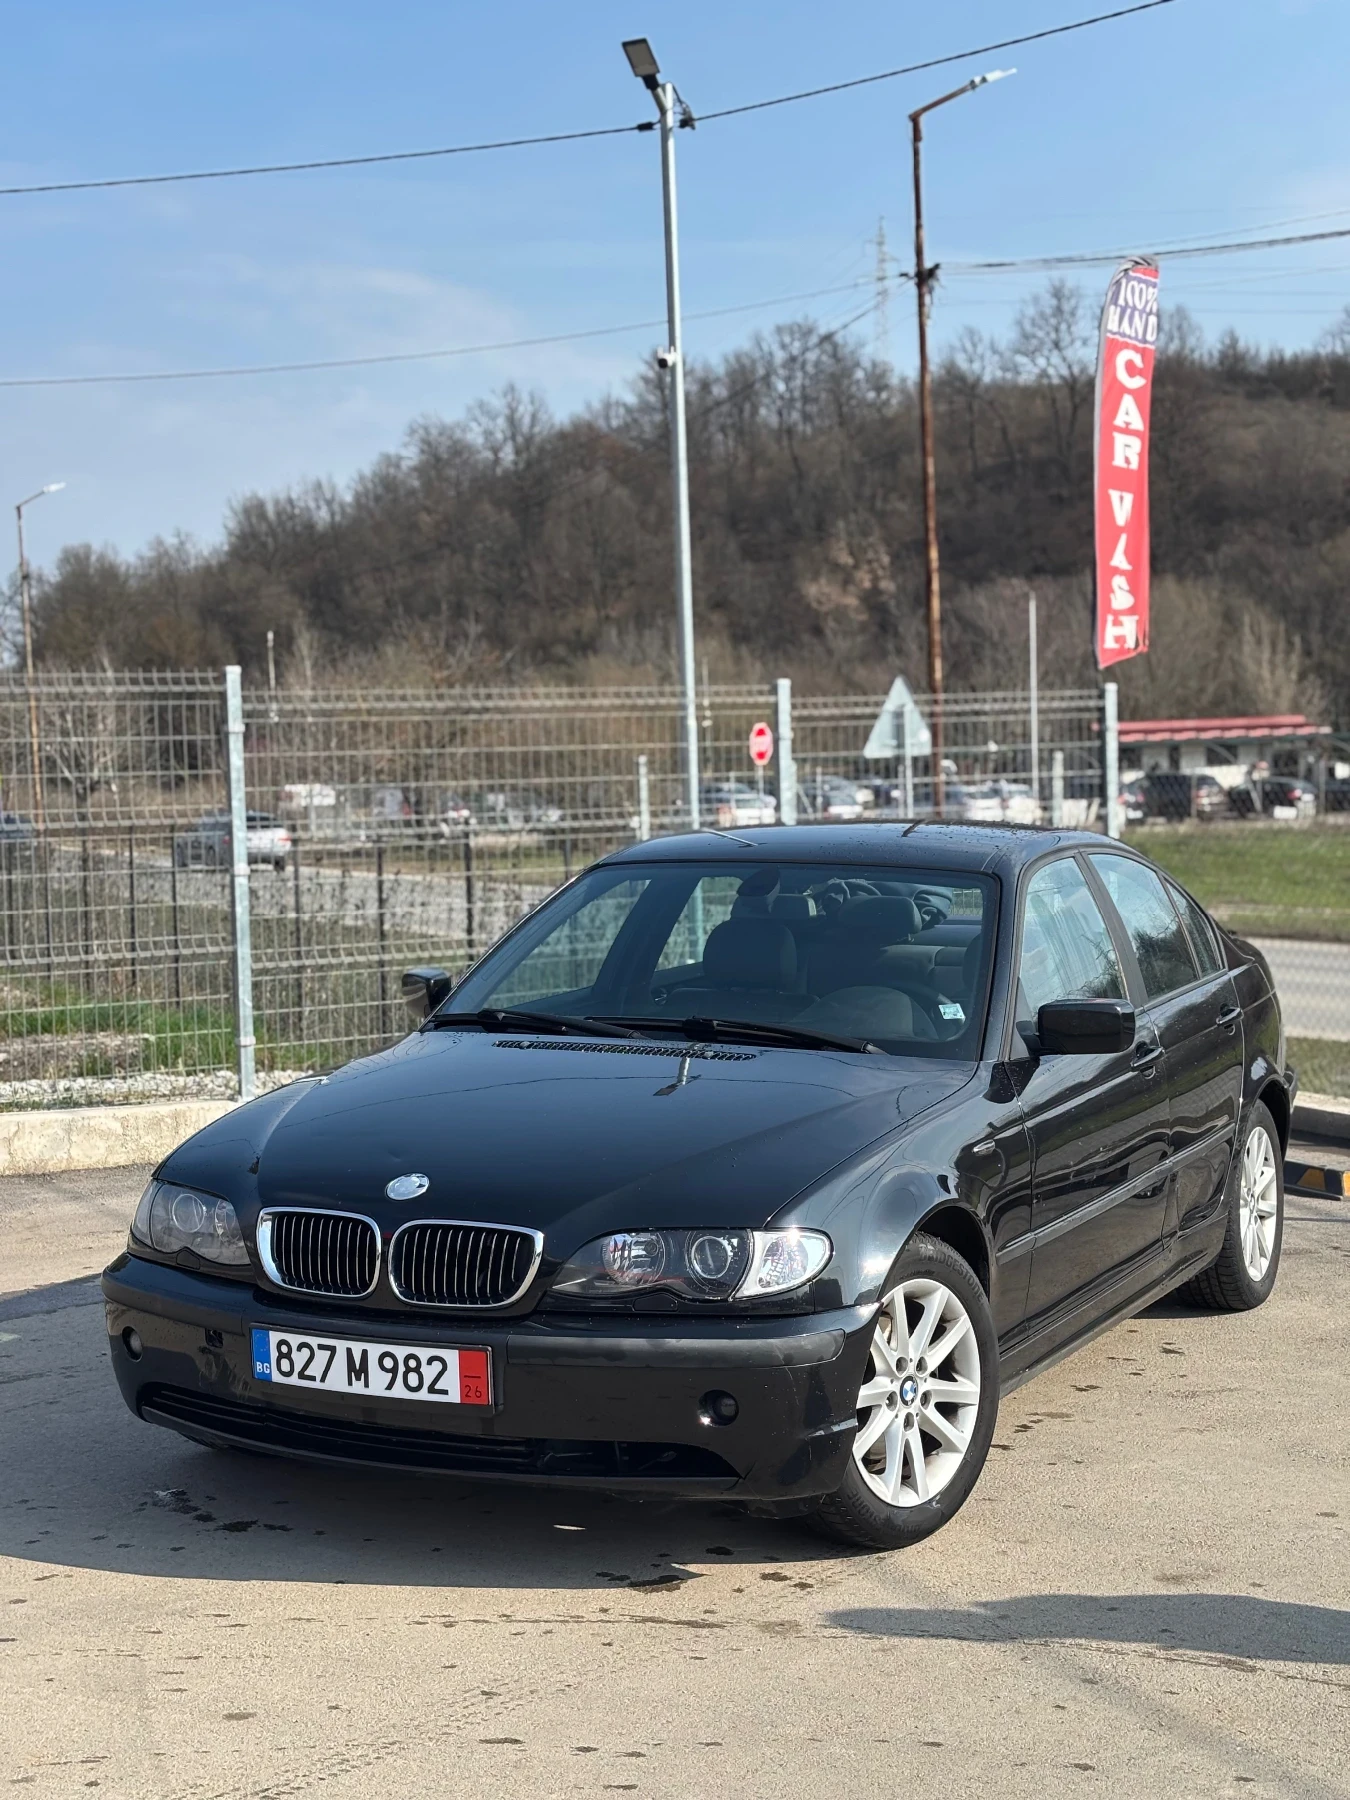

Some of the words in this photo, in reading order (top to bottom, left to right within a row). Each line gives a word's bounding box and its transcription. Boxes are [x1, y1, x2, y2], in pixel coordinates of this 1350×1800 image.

[1107, 304, 1158, 342] HAND
[1112, 349, 1147, 470] CAR
[256, 1361, 271, 1374] BG
[275, 1338, 337, 1383] 827
[346, 1346, 370, 1389] M
[377, 1350, 449, 1396] 982
[464, 1384, 483, 1399] 26
